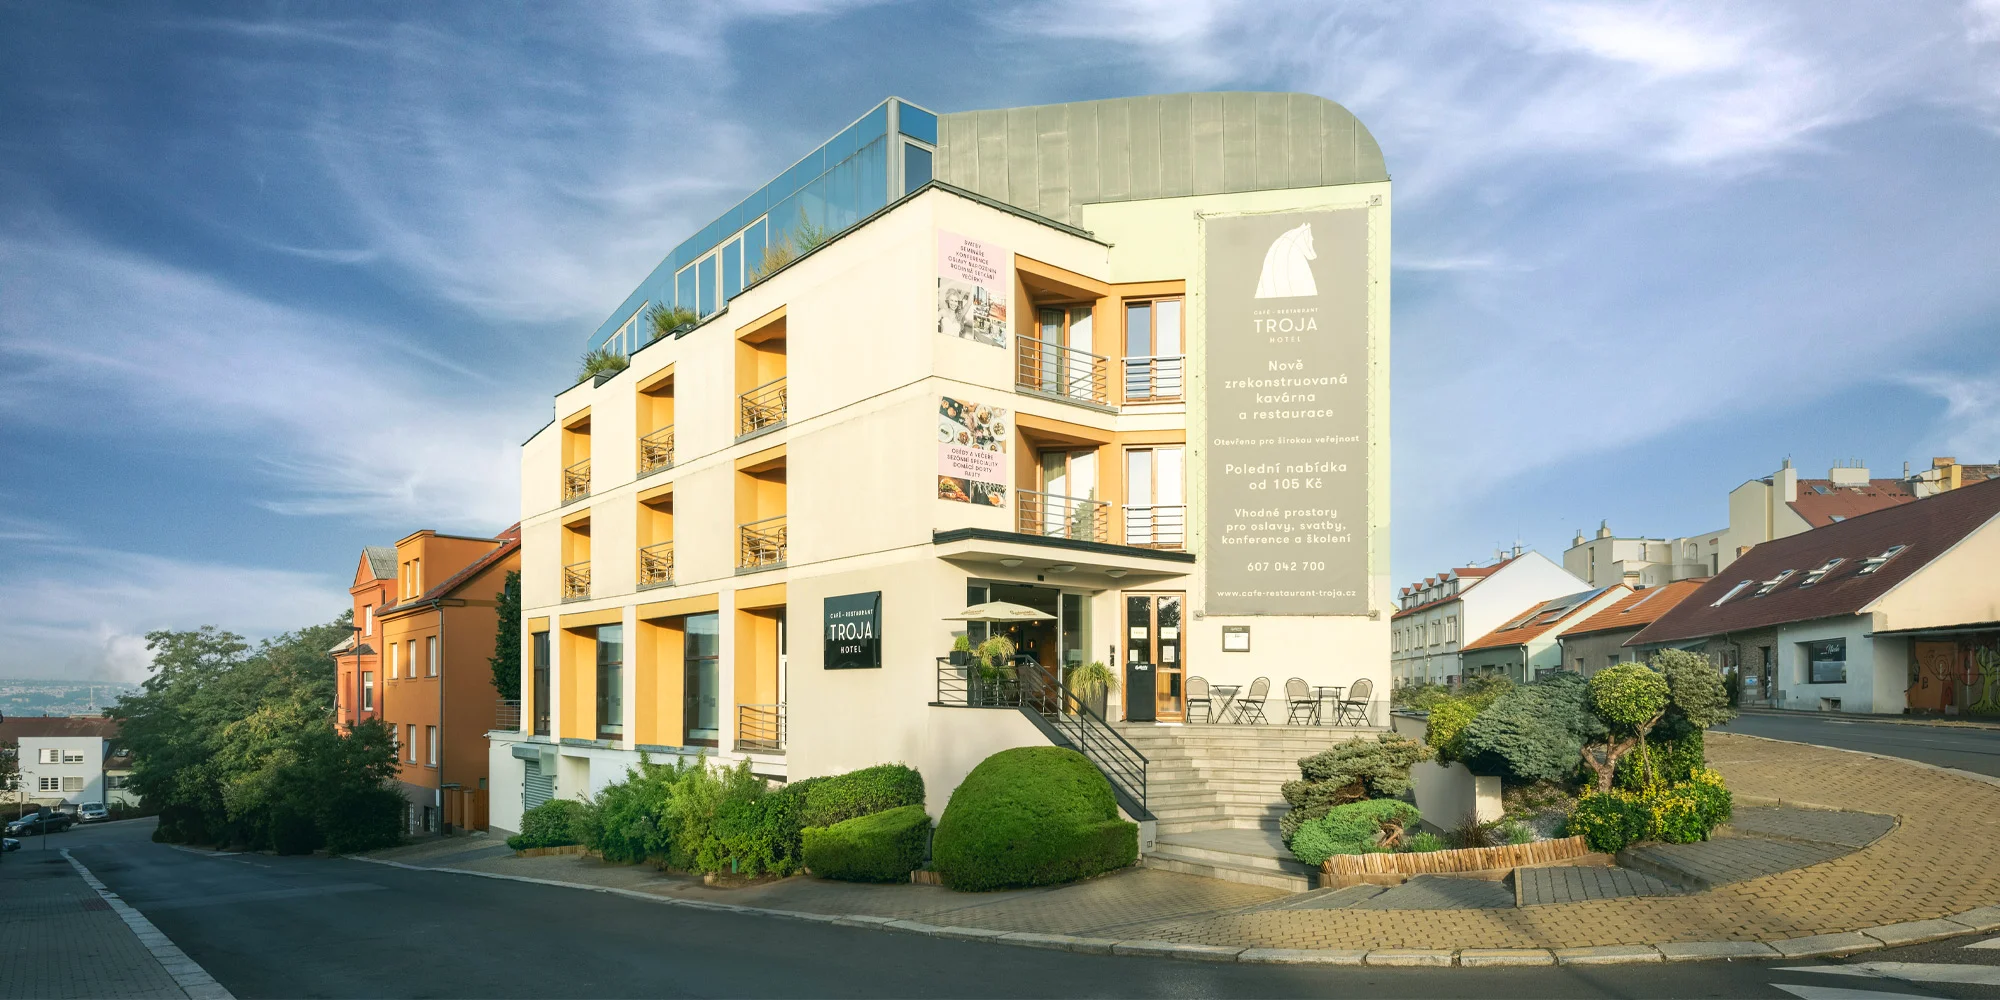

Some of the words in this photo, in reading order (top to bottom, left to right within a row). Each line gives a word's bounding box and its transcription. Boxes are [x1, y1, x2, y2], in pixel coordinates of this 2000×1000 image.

[956, 252, 988, 265] KONFERENCE
[1254, 318, 1318, 333] TROJA
[1269, 359, 1304, 371] Nově
[1225, 374, 1348, 388] zrekonstruovaná
[1256, 393, 1315, 403] kavárna
[1239, 411, 1247, 420] a
[1254, 407, 1333, 420] restaurace
[1214, 438, 1256, 446] Otevřeno
[1315, 435, 1360, 444] veřejnost
[1225, 462, 1280, 474] Polední
[1287, 462, 1347, 473] nabídka
[1249, 479, 1266, 490] od
[1274, 478, 1300, 489] 105
[1306, 478, 1323, 488] Kč
[1235, 508, 1279, 517] Vhodné
[1284, 508, 1337, 519] prostory
[1226, 523, 1246, 533] pro
[1251, 522, 1295, 531] oslavy,
[1300, 521, 1346, 531] svatby,
[1222, 535, 1290, 545] konference
[1307, 534, 1351, 543] školení
[1247, 562, 1268, 571] 607
[1275, 562, 1296, 571] 042
[1303, 562, 1325, 571] 700
[1217, 589, 1356, 598] www.cafe-restaurant-troja.cz
[846, 609, 873, 617] RESTAURANT
[830, 621, 872, 641] TROJA
